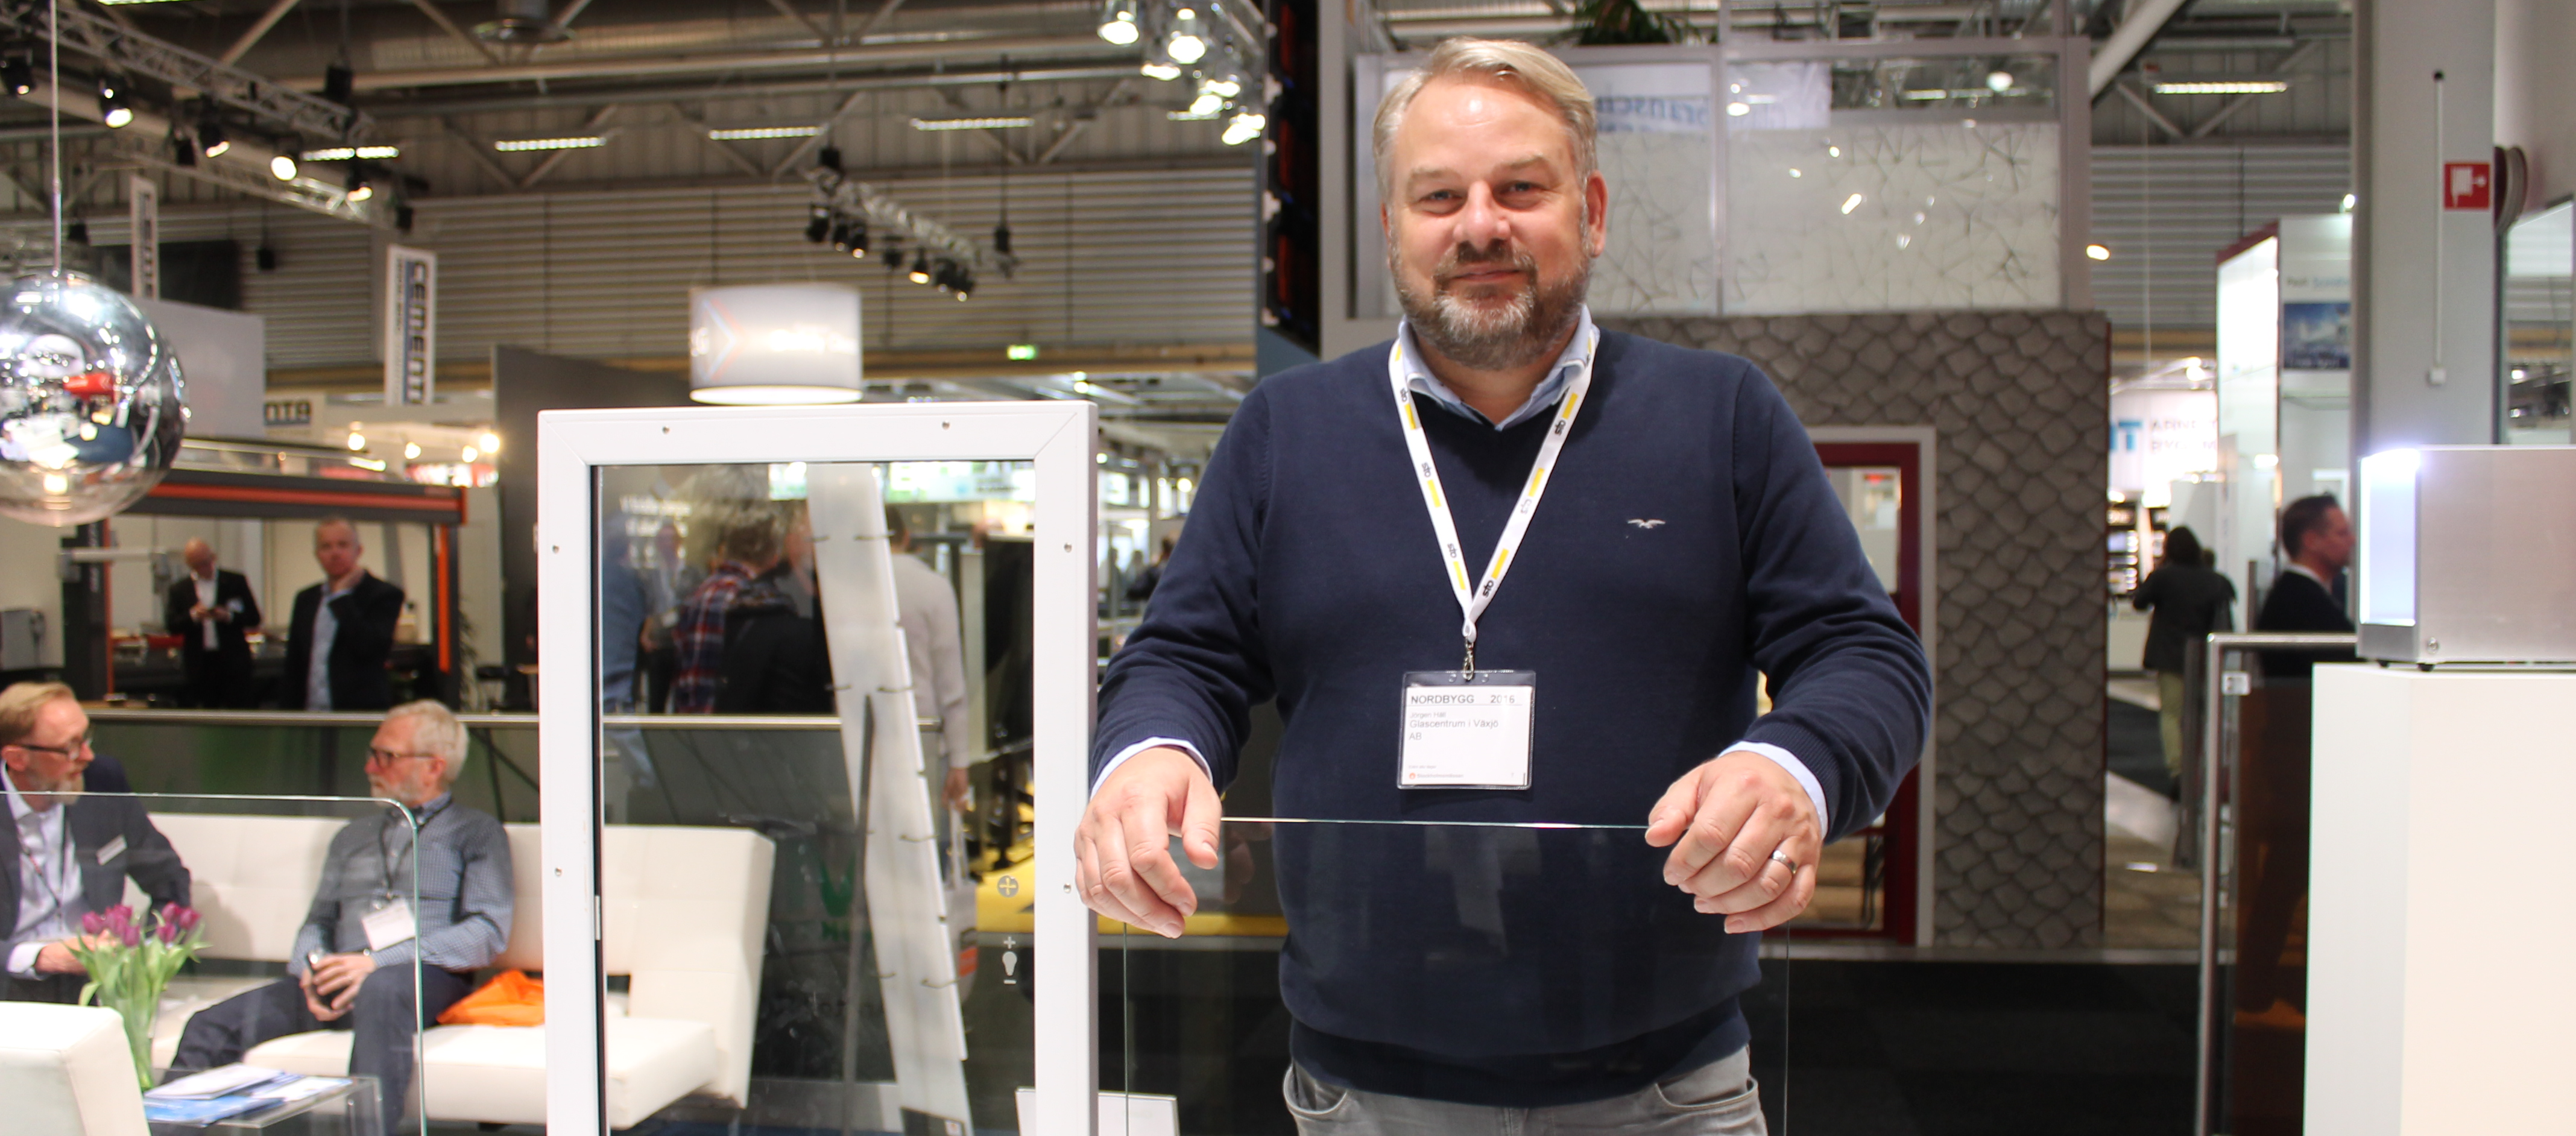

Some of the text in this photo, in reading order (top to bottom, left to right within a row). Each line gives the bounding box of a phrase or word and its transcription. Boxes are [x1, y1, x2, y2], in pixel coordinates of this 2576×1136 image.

[1411, 695, 1515, 704] NORDBYGG 2016
[1410, 720, 1465, 728] Glascentrum
[1474, 719, 1499, 730] Växjö
[1409, 731, 1422, 740] AB
